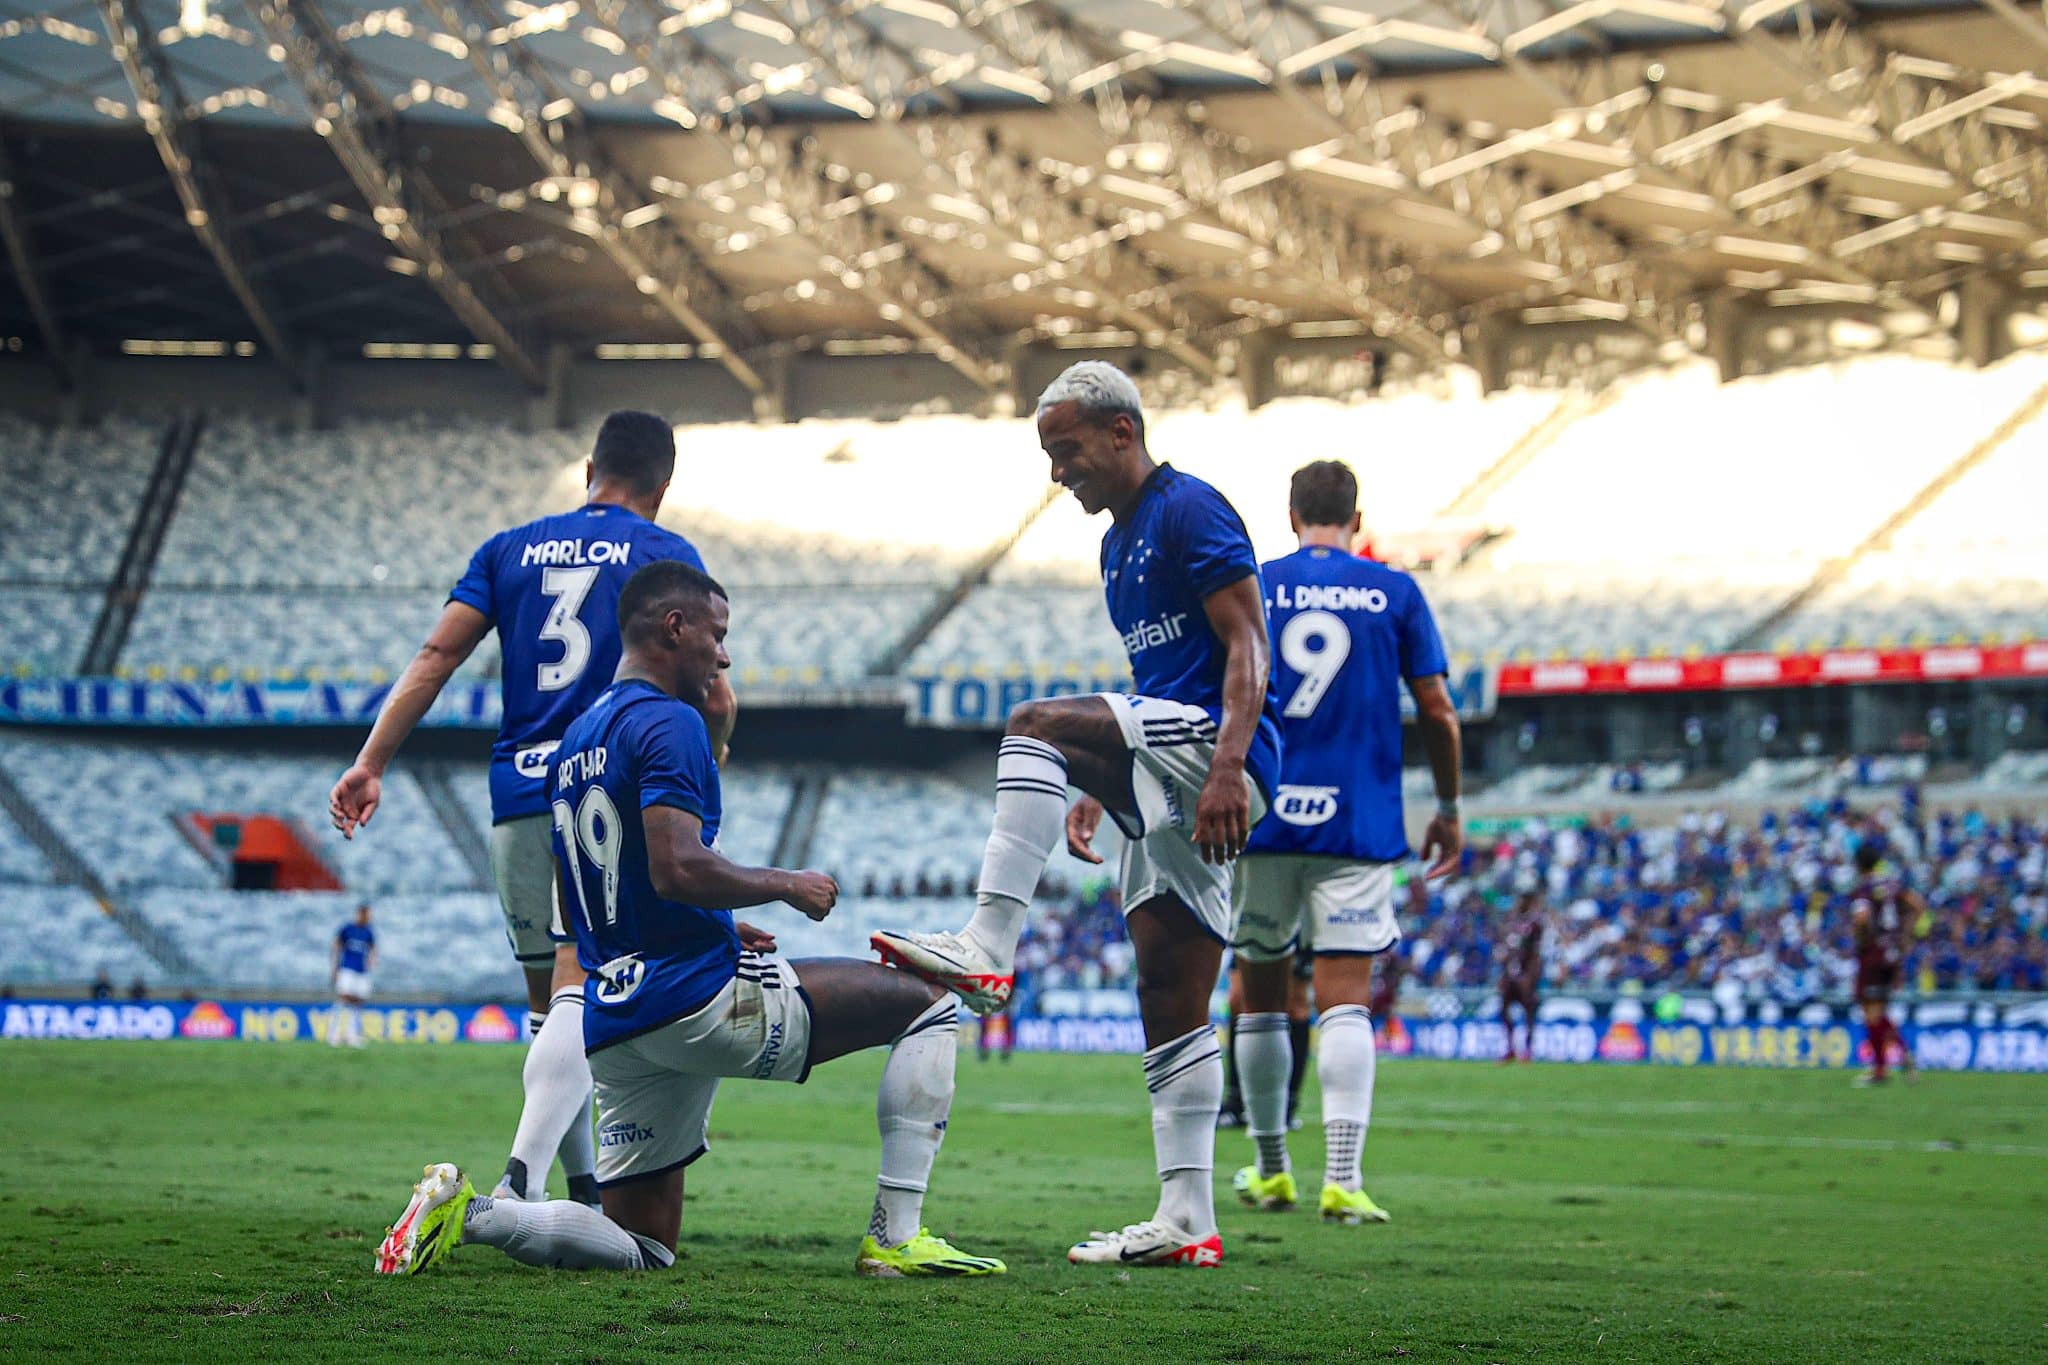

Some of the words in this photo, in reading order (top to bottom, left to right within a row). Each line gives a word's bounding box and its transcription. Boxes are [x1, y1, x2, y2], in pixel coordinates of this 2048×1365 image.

[521, 538, 631, 567] MARLON
[537, 566, 600, 691] 3
[1125, 612, 1187, 654] etfair
[1280, 610, 1351, 718] 9
[1283, 798, 1326, 815] BH
[553, 784, 623, 932] 19
[3, 1004, 175, 1039] ATACADO
[241, 1007, 299, 1041] NO
[308, 1008, 459, 1043] VREJO
